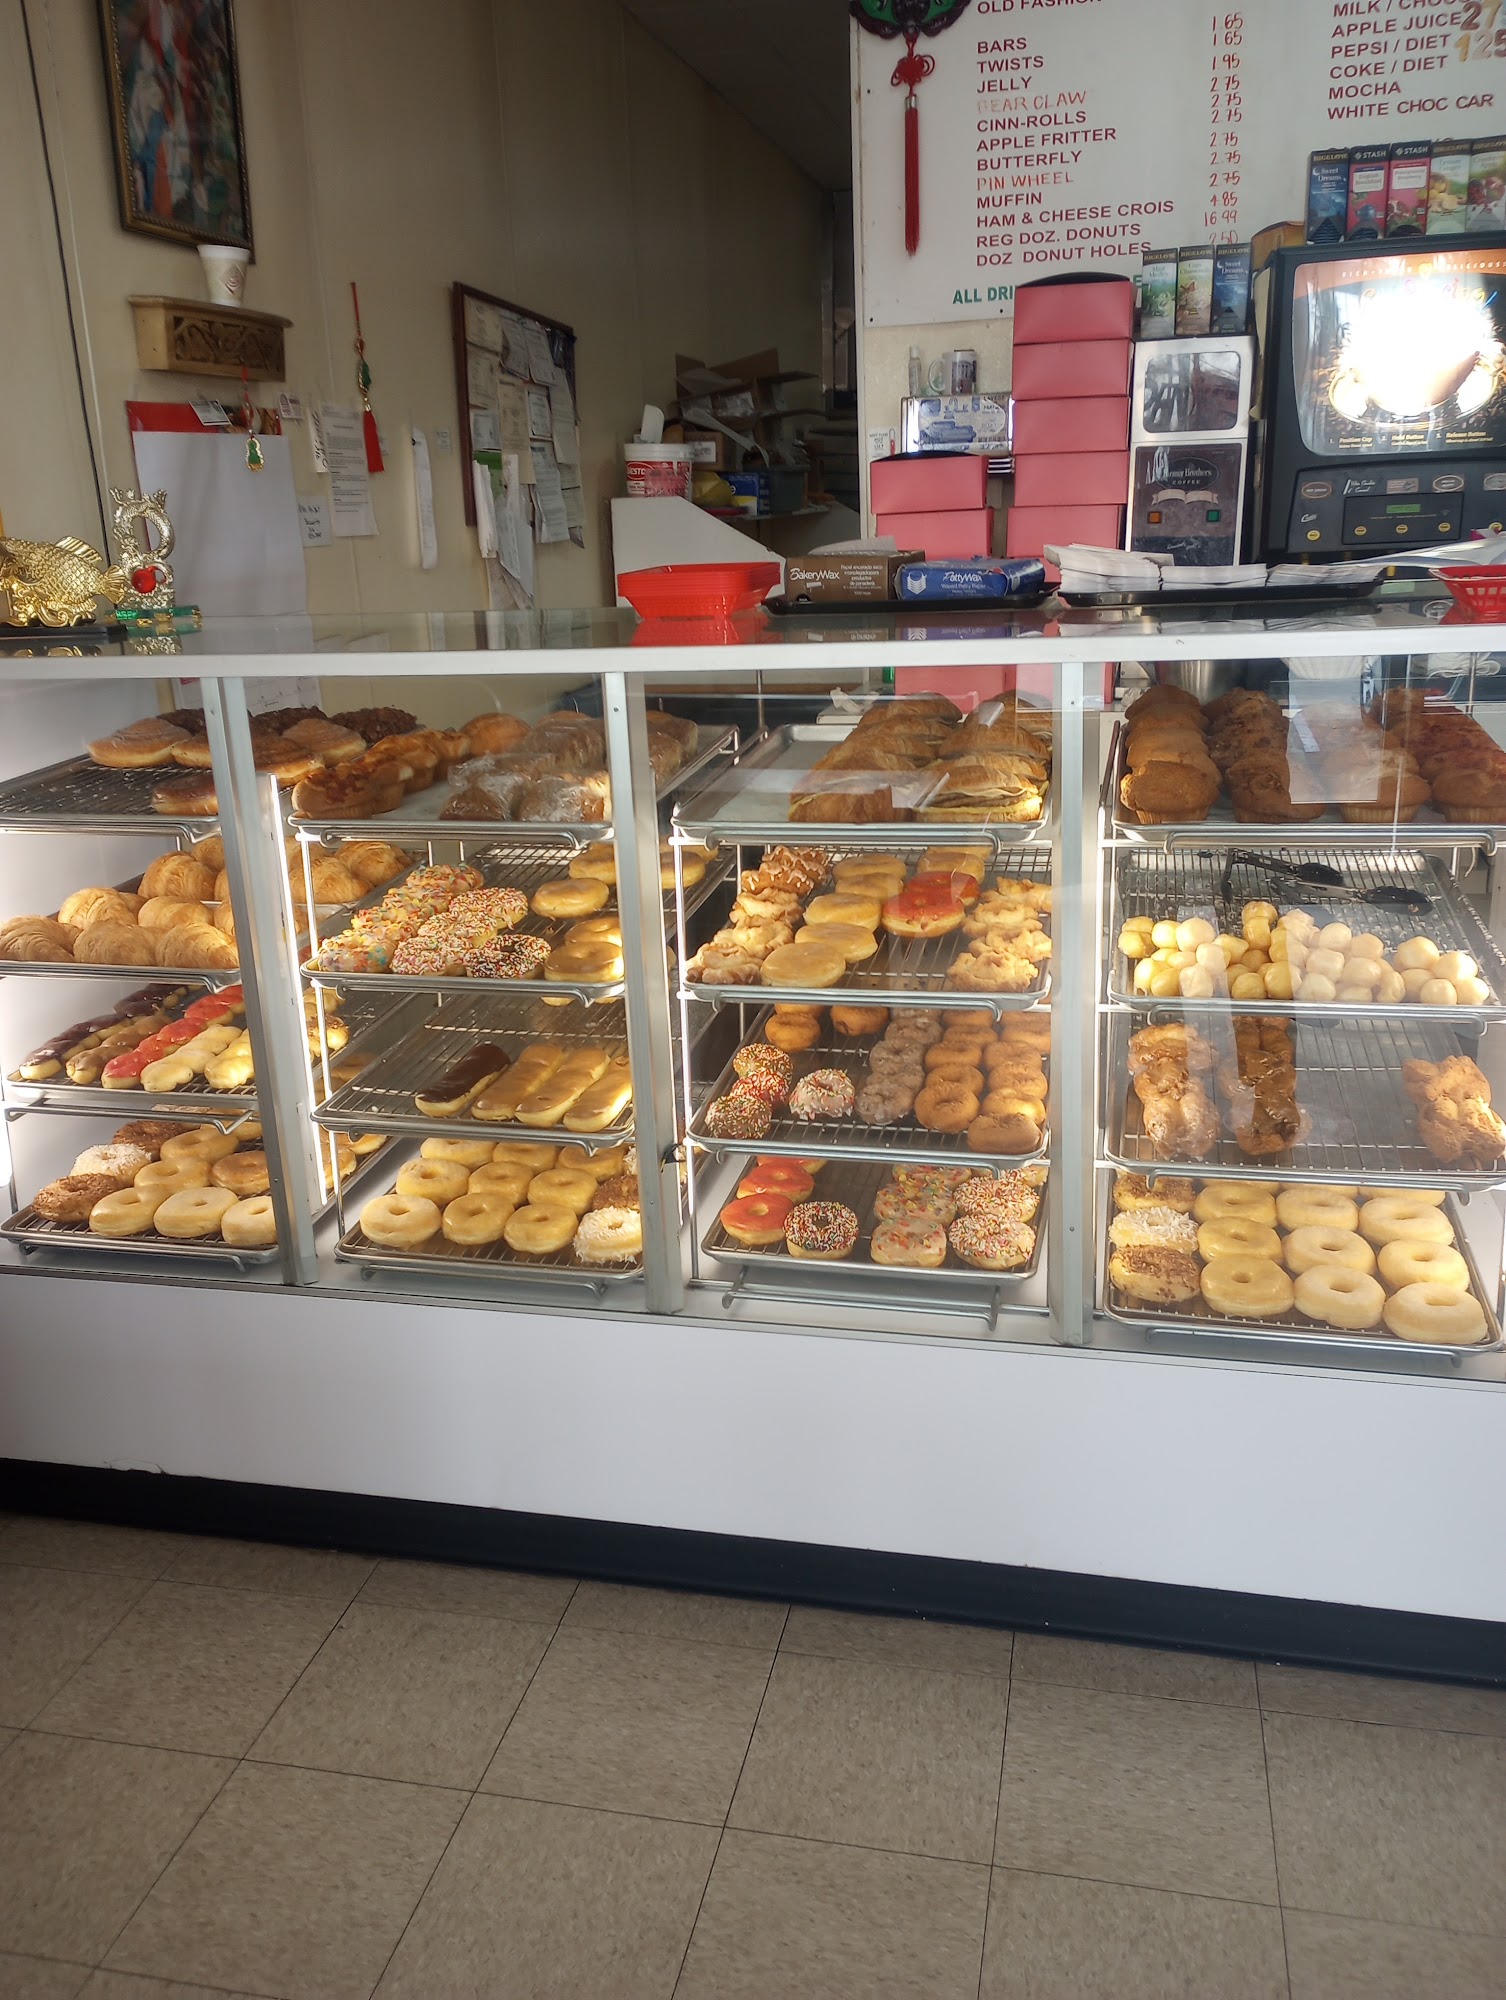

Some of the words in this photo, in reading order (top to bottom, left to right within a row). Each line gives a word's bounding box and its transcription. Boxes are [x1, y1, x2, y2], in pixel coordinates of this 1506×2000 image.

[977, 0, 1014, 14] OLD
[1333, 0, 1380, 17] MILK
[1331, 19, 1397, 38] APPLE
[1403, 12, 1461, 31] JUICE
[977, 37, 1027, 54] BARS
[1331, 41, 1388, 59] PEPSI
[1393, 39, 1400, 53] /
[1406, 33, 1451, 51] DIET
[977, 55, 1044, 73] TWISTS
[1329, 62, 1385, 79] COKE
[1391, 60, 1397, 74] /
[1403, 55, 1448, 72] DIET
[977, 76, 1032, 93] JELLY
[1329, 81, 1401, 100] MOCHA
[1034, 91, 1086, 110] CLAW
[1328, 102, 1389, 120] WHITE
[1397, 97, 1448, 114] CHOC
[1456, 94, 1494, 110] CAR
[977, 110, 1086, 132] CINN-ROLLS
[977, 135, 1035, 152] APPLE
[1041, 127, 1117, 147] FRITTER
[1313, 153, 1348, 161] BIGELOW
[1362, 151, 1386, 159] STASH
[1404, 146, 1428, 155] STASH
[977, 151, 1083, 171] BUTTERFLY
[977, 175, 1005, 191] PIN
[1012, 171, 1074, 188] WHEEL
[977, 192, 1042, 209] MUFFIN
[977, 213, 1015, 228] HAM
[1022, 212, 1034, 224] &
[1039, 205, 1111, 223] CHEESE
[1117, 200, 1174, 217] CROIS
[977, 233, 1013, 248] REG
[1019, 229, 1060, 245] DOZ.
[1066, 223, 1141, 241] DONUTS
[977, 252, 1012, 266] DOZ
[1023, 246, 1083, 264] DONUT
[1090, 241, 1151, 258] HOLES
[952, 289, 982, 304] ALL
[790, 567, 840, 581] BakeryWax
[943, 571, 982, 583] PattyWax
